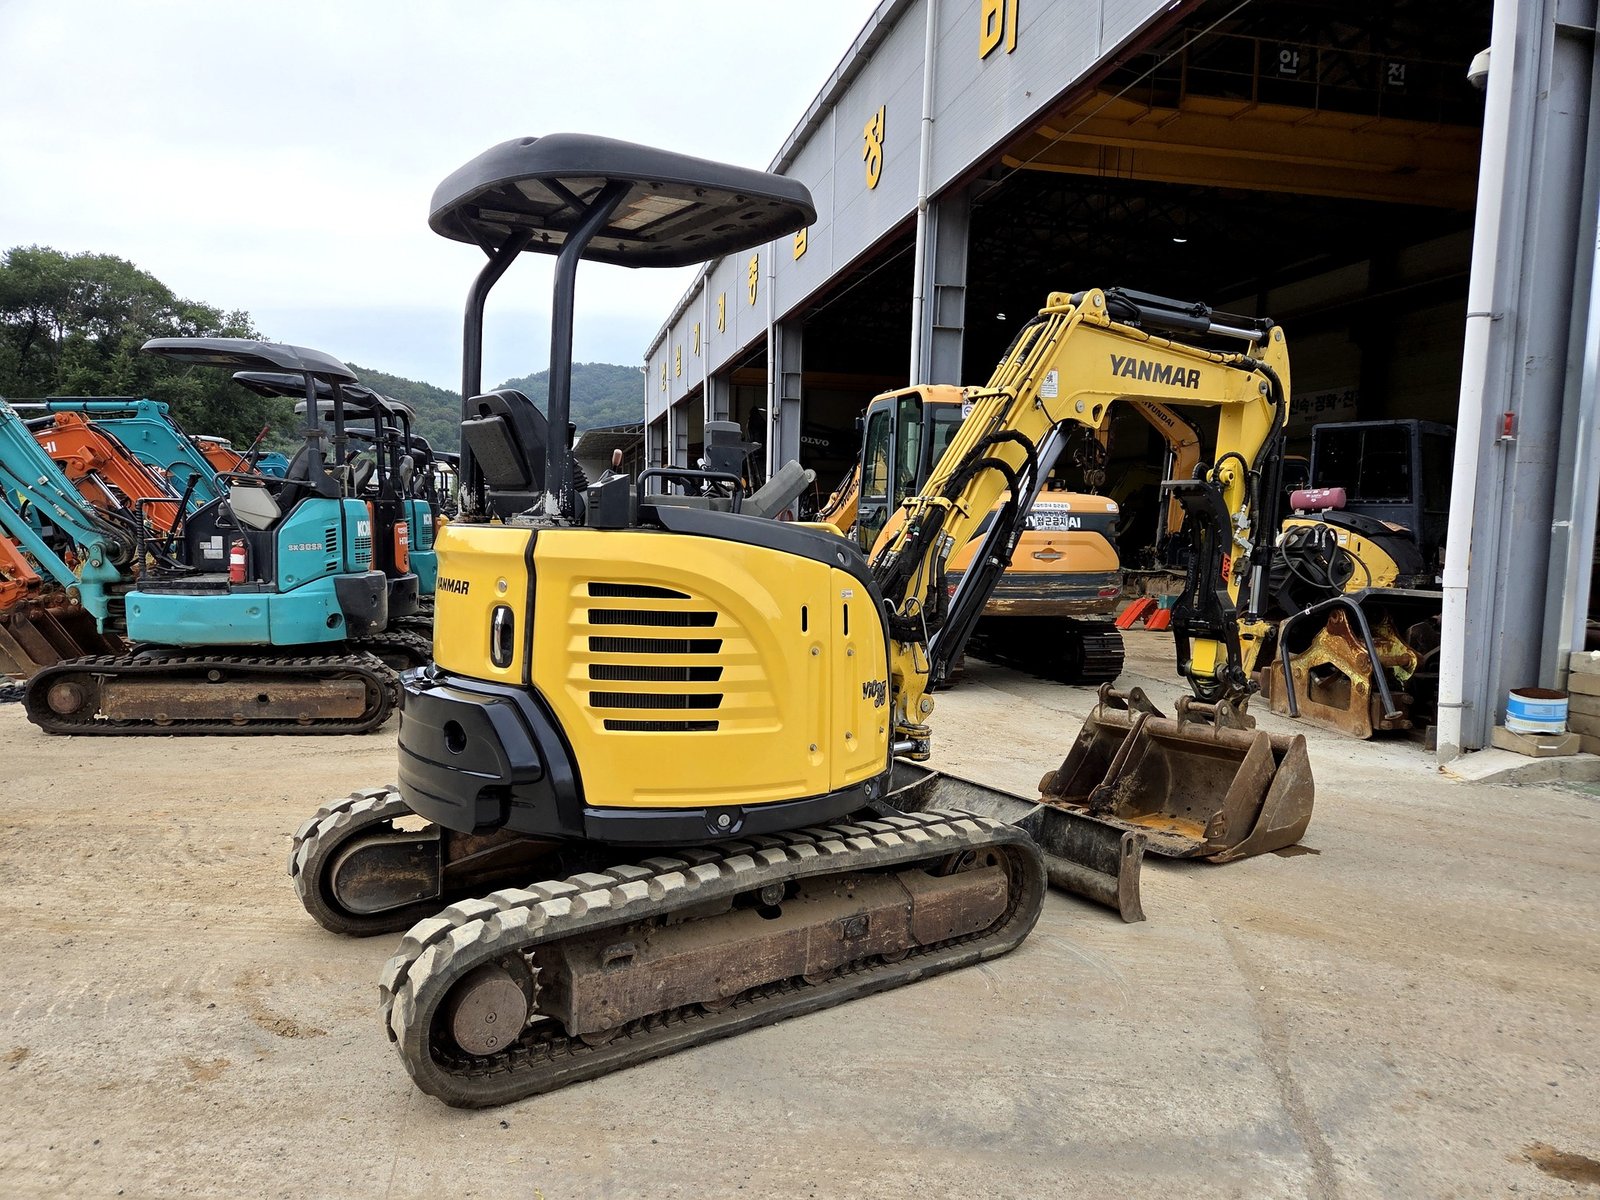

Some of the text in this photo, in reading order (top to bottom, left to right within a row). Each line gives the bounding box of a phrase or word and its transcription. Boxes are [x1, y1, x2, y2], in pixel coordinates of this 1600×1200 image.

[1279, 49, 1407, 86] 안 전
[748, 253, 759, 306] 종
[863, 105, 886, 190] 정
[978, 0, 1019, 60] 비
[1110, 354, 1201, 389] YANMAR
